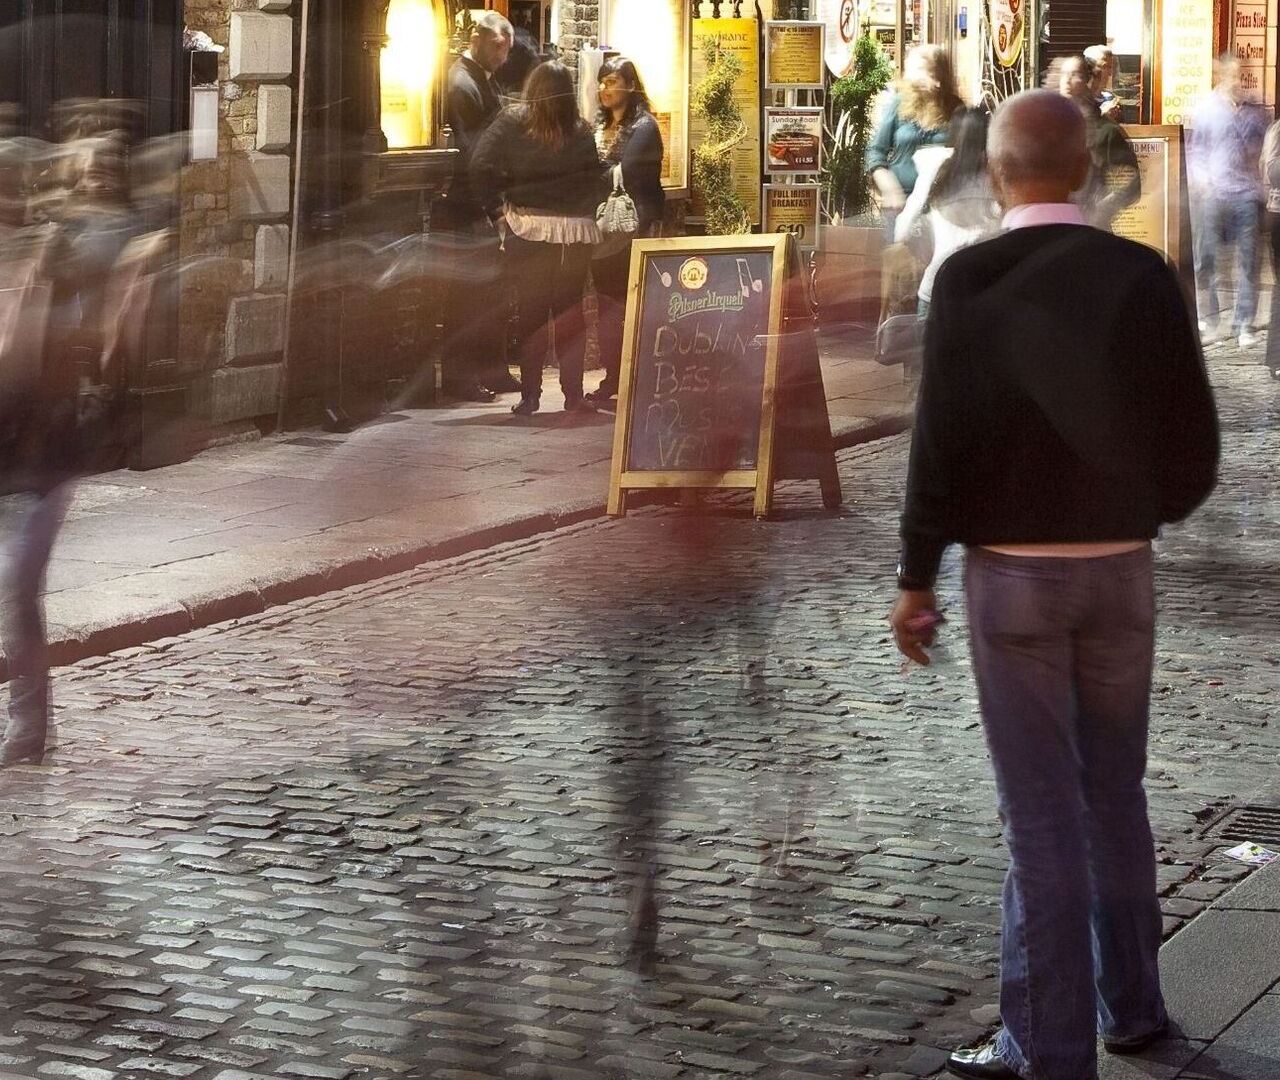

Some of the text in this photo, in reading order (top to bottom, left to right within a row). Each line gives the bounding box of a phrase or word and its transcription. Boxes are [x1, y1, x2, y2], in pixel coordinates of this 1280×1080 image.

[1236, 10, 1266, 29] Pizza Slice
[1235, 42, 1264, 61] Ice Cream
[772, 116, 819, 125] Sunday Roast
[773, 190, 811, 198] FULL IRISH
[771, 199, 812, 208] BREAKFAST
[776, 223, 806, 241] €10
[668, 291, 708, 322] Pilsner
